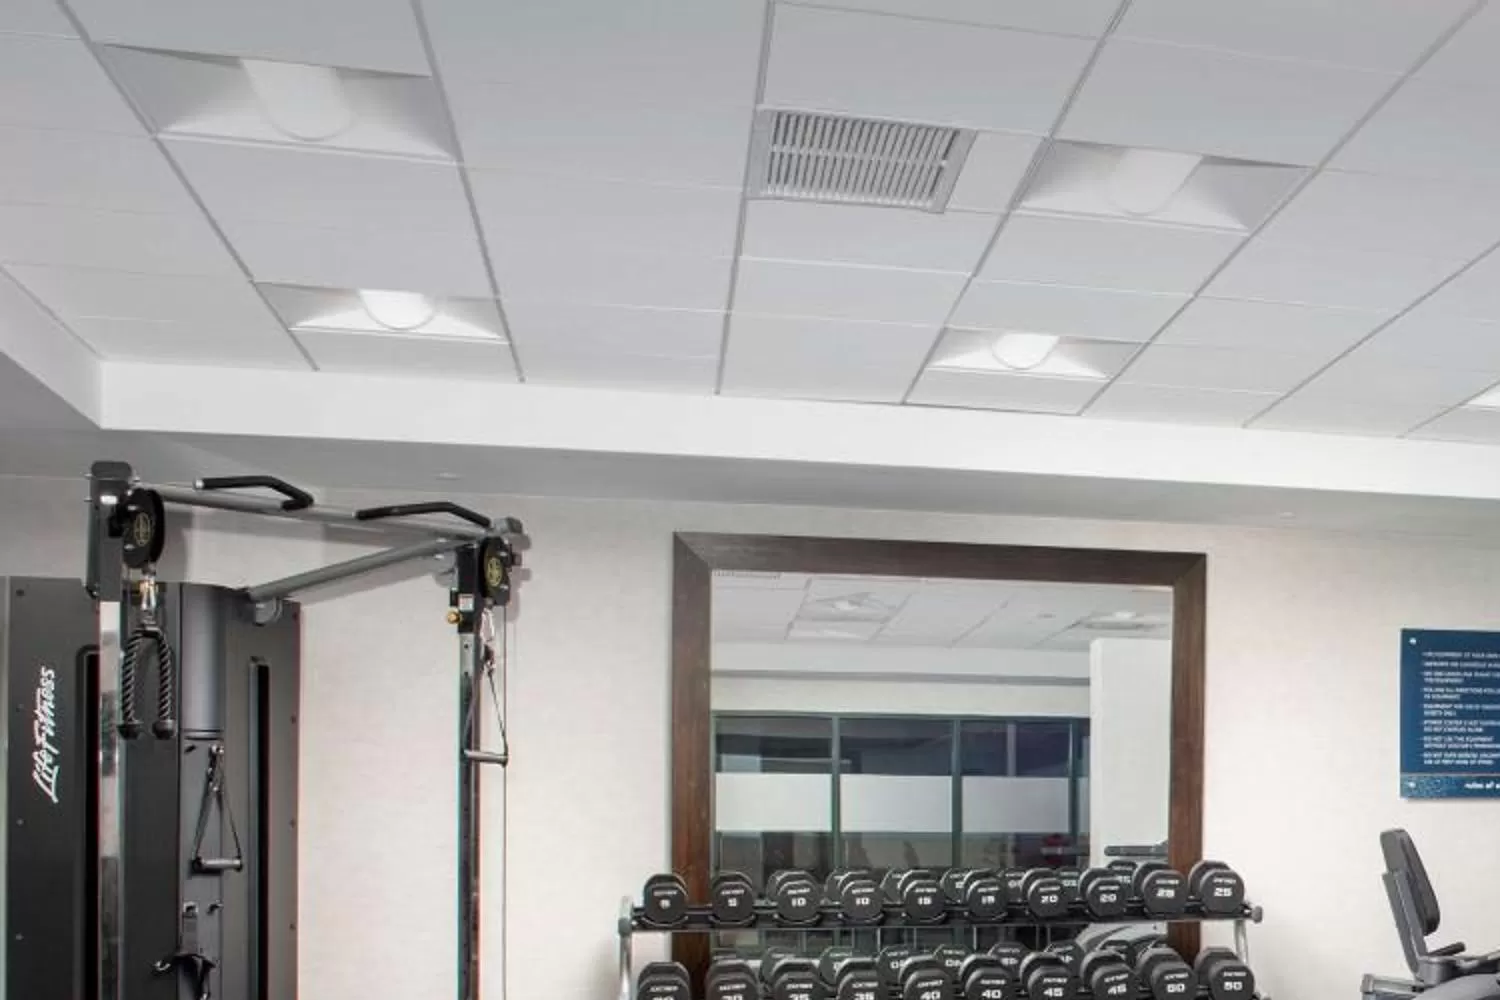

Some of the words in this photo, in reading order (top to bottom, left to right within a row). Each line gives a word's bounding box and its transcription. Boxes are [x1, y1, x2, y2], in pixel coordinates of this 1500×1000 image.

[1213, 887, 1233, 897] 25
[791, 896, 807, 907] 10
[855, 897, 870, 906] 10
[920, 990, 941, 1000] 40
[981, 989, 1002, 999] 40
[1043, 987, 1064, 998] 45
